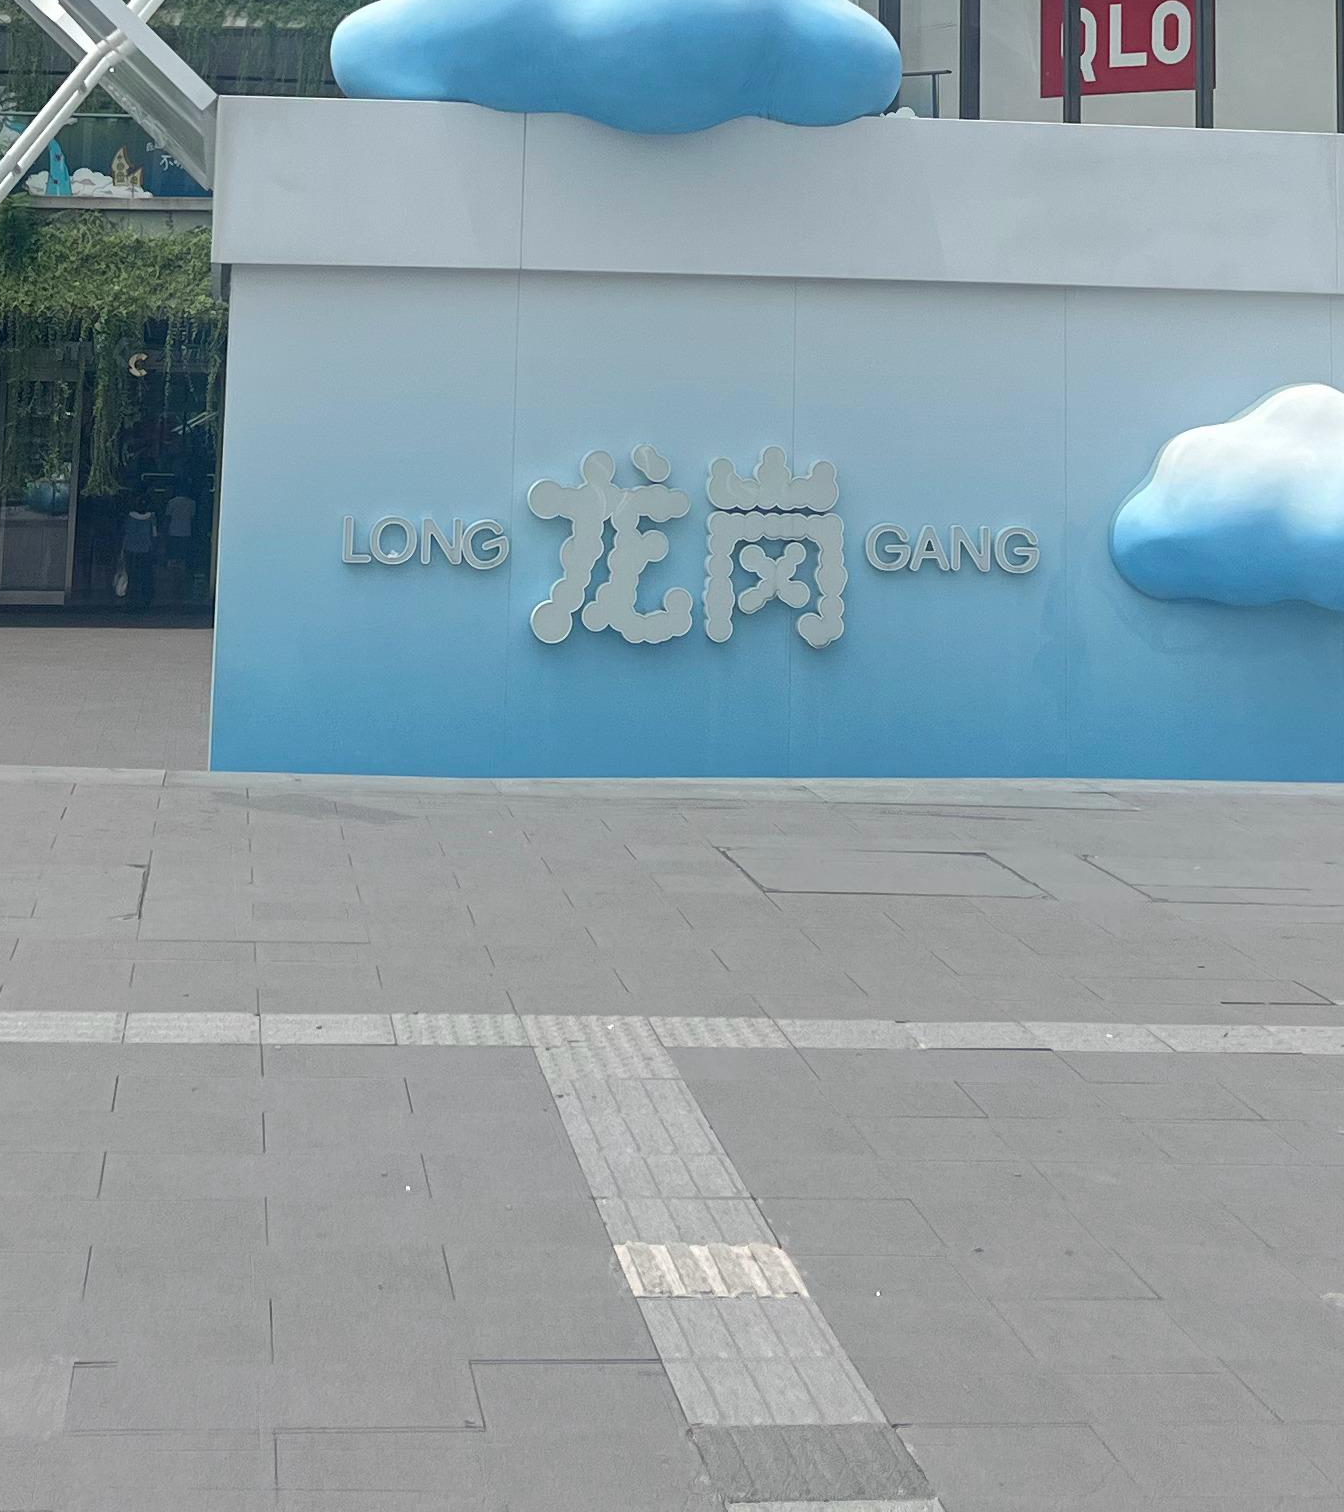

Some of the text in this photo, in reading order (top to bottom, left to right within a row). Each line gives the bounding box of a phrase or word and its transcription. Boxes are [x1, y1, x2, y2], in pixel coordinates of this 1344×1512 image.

[1061, 0, 1192, 82] QLO
[341, 443, 1040, 648] LONG 龙岗 GANG
